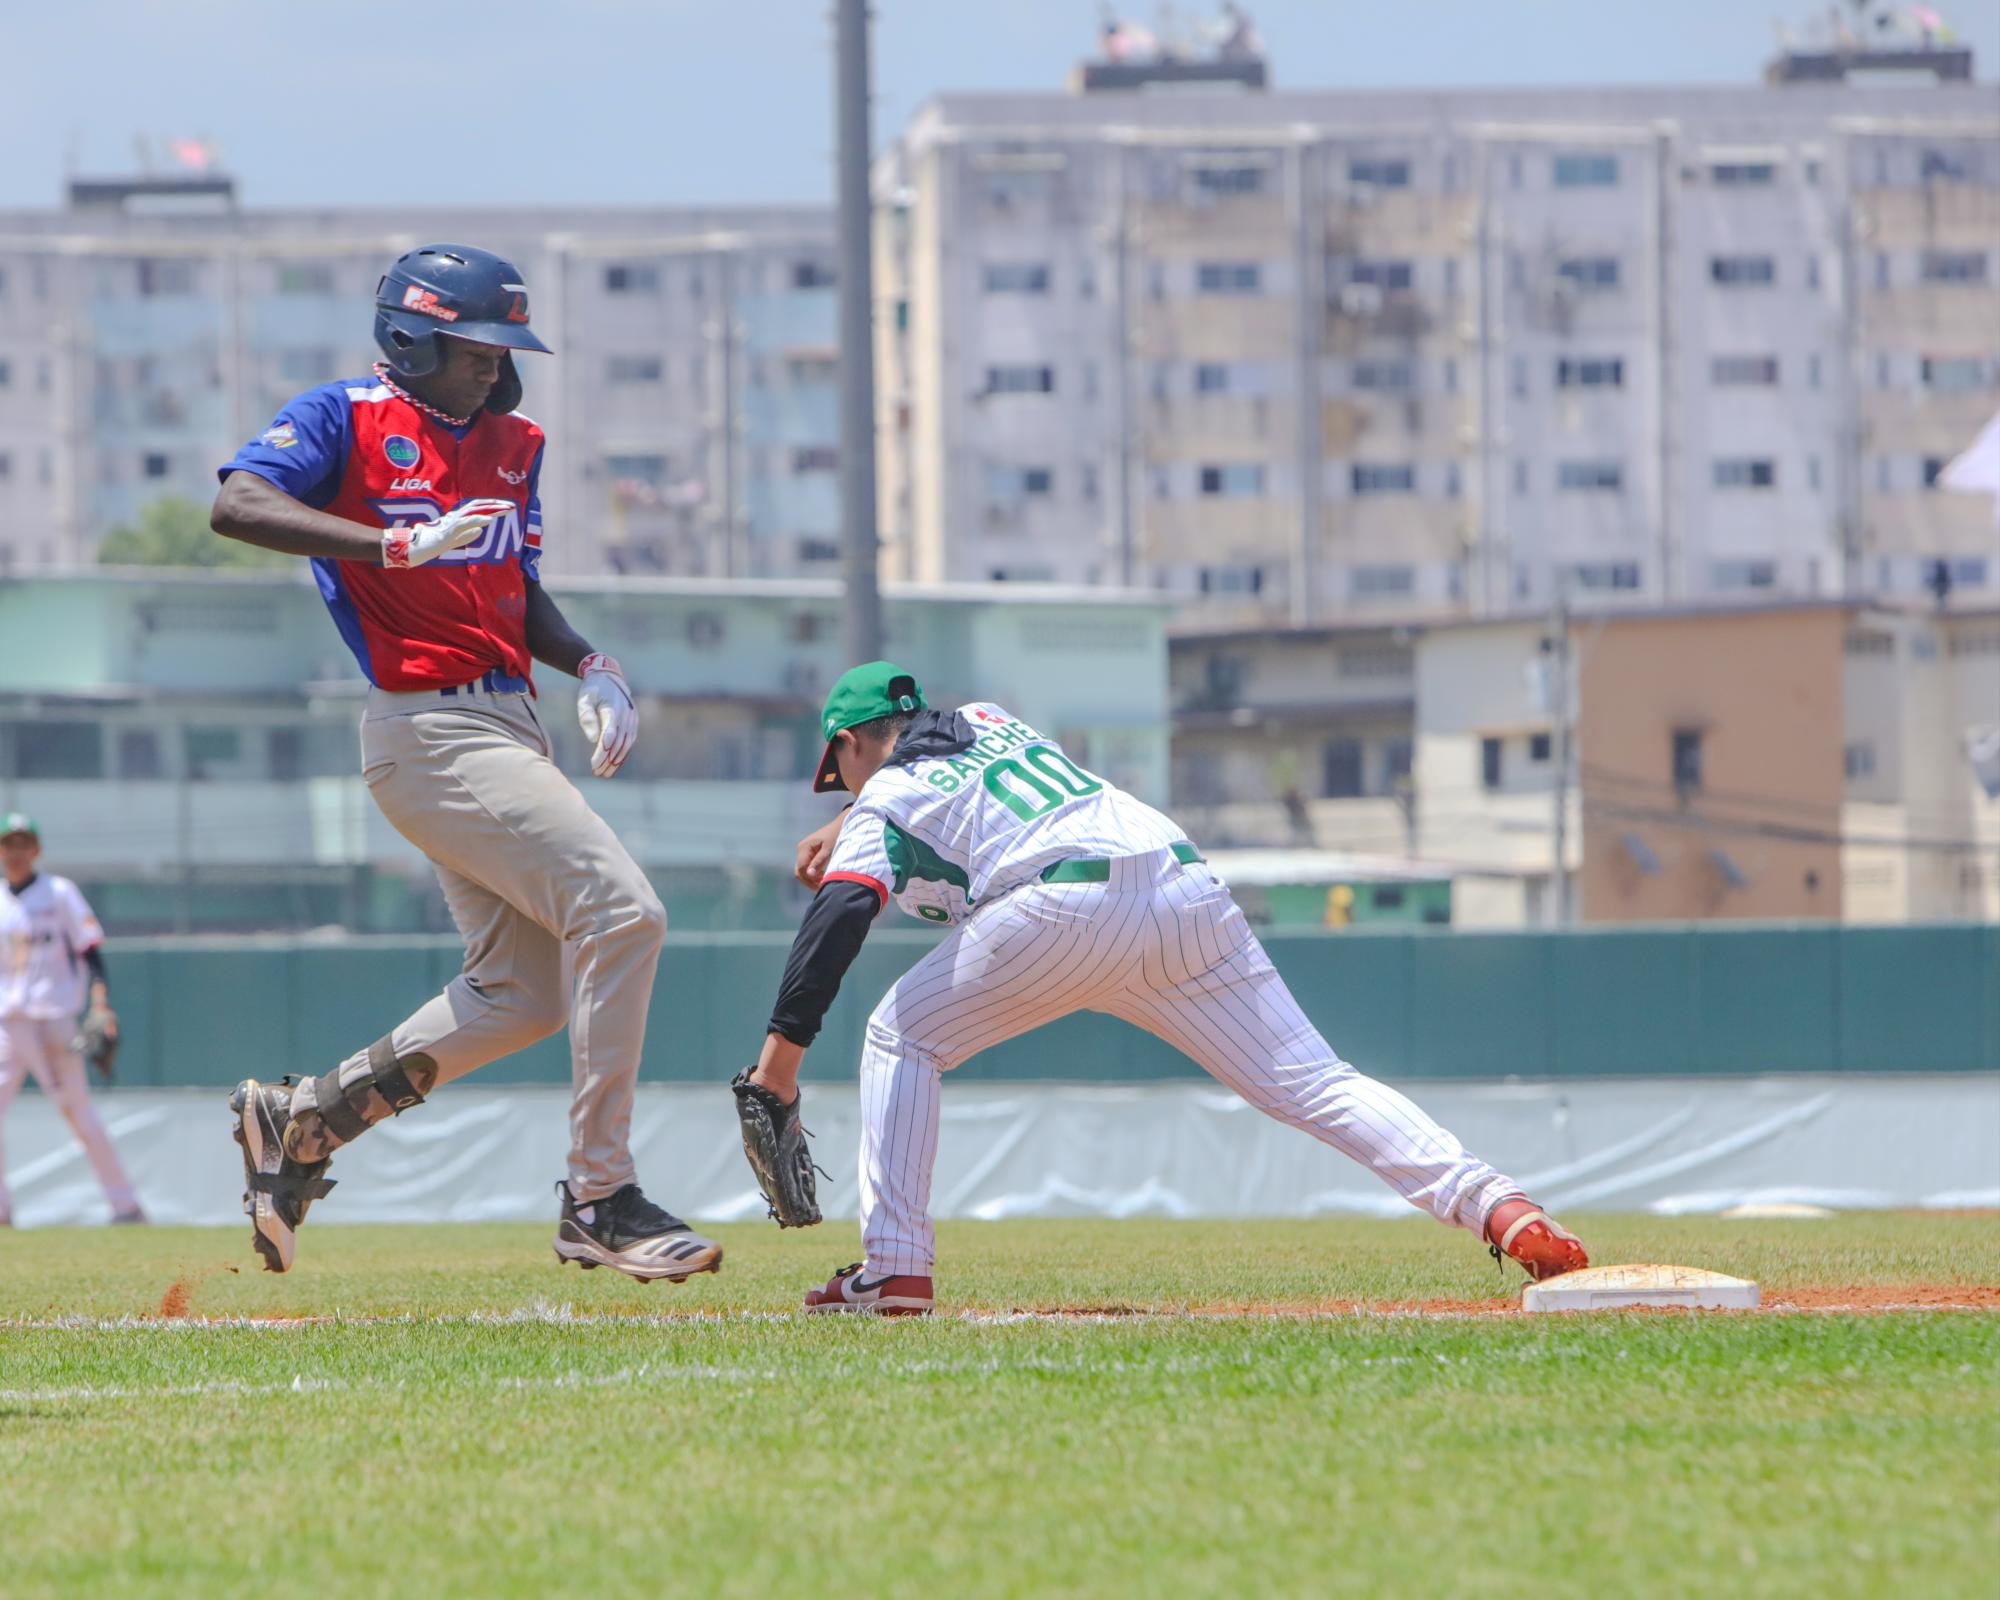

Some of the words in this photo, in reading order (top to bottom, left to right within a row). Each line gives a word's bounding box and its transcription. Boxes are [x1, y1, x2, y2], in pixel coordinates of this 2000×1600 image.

[389, 477, 432, 492] LIGA
[928, 721, 1050, 793] SANCHE
[983, 744, 1104, 822] 00
